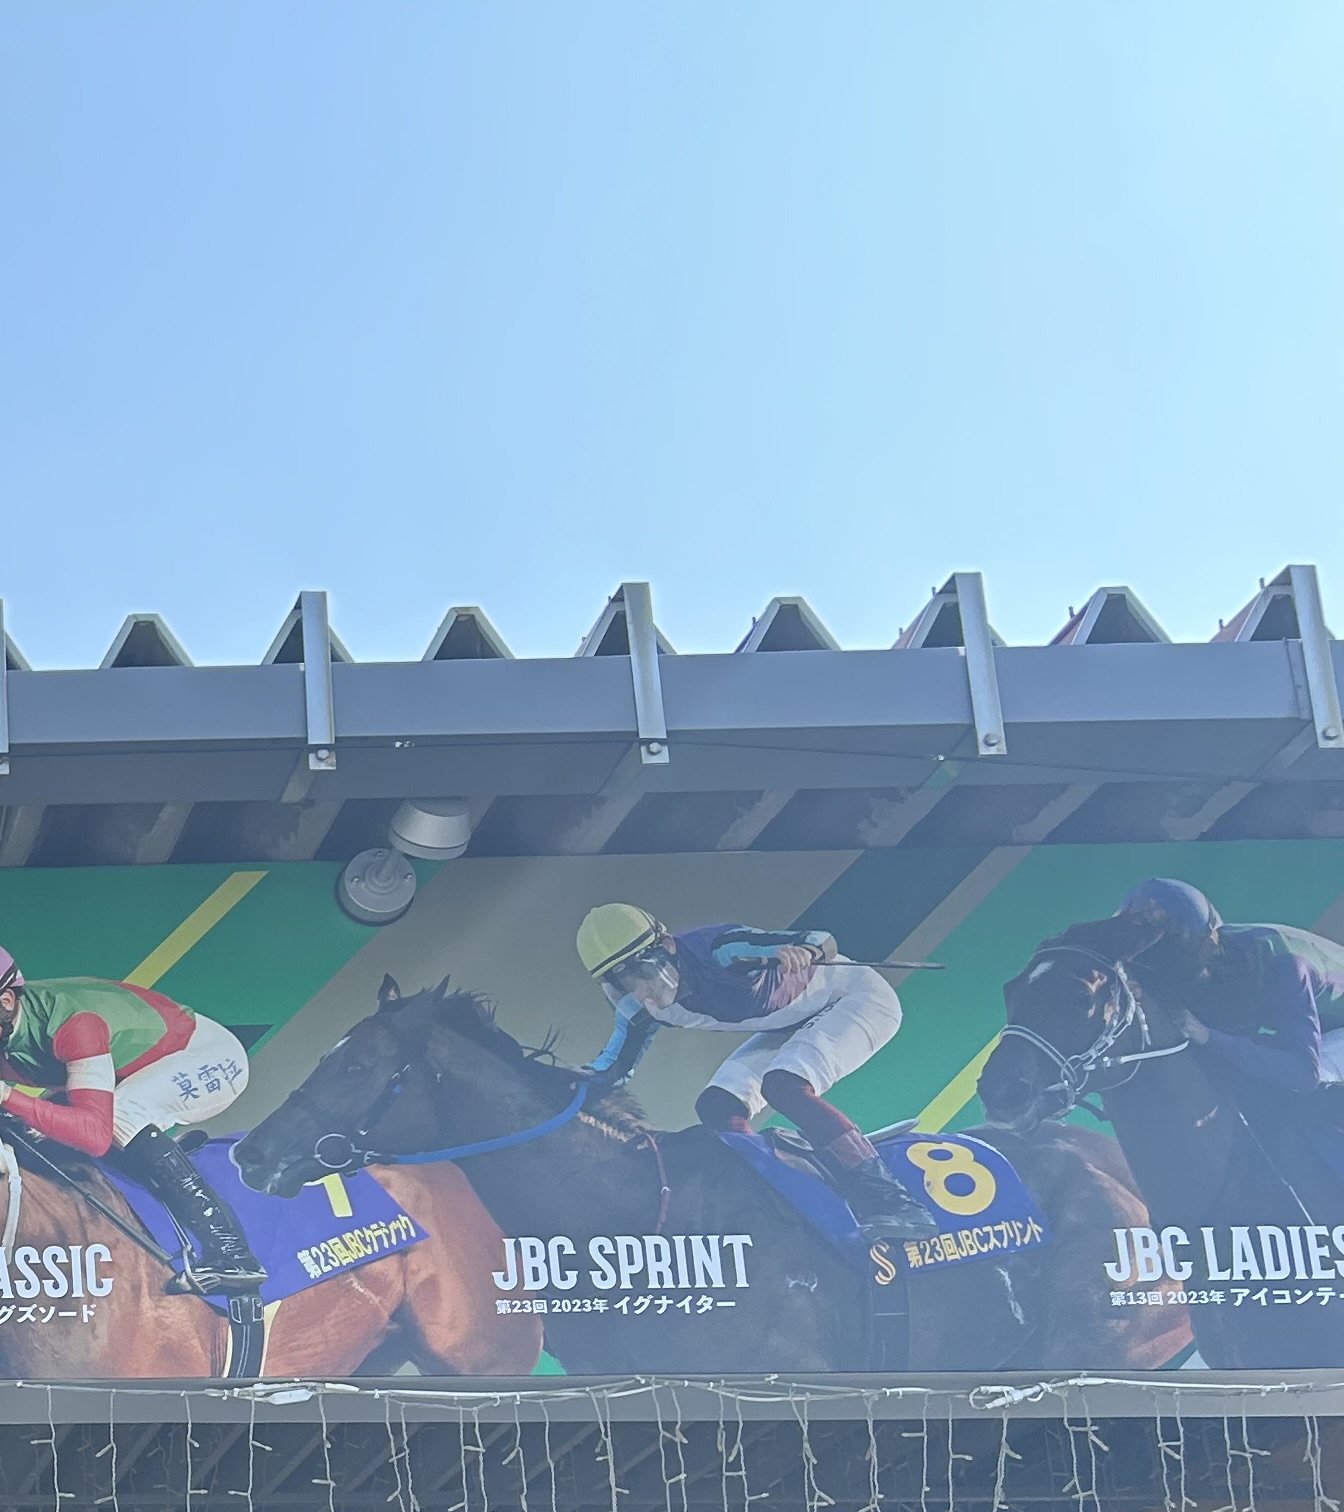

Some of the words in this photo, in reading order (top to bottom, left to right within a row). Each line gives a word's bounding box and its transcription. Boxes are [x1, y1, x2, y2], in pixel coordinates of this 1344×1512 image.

[906, 1141, 996, 1216] 8
[491, 1235, 579, 1291] JBC
[588, 1233, 754, 1290] SPRINT
[1103, 1226, 1194, 1282] JBC
[495, 1299, 548, 1315] 第23回
[551, 1298, 609, 1314] 2023年
[613, 1295, 736, 1315] イグナイター
[1109, 1291, 1163, 1307] 第13回
[1167, 1289, 1226, 1305] 2023年
[1230, 1287, 1344, 1307] アイコンテ
